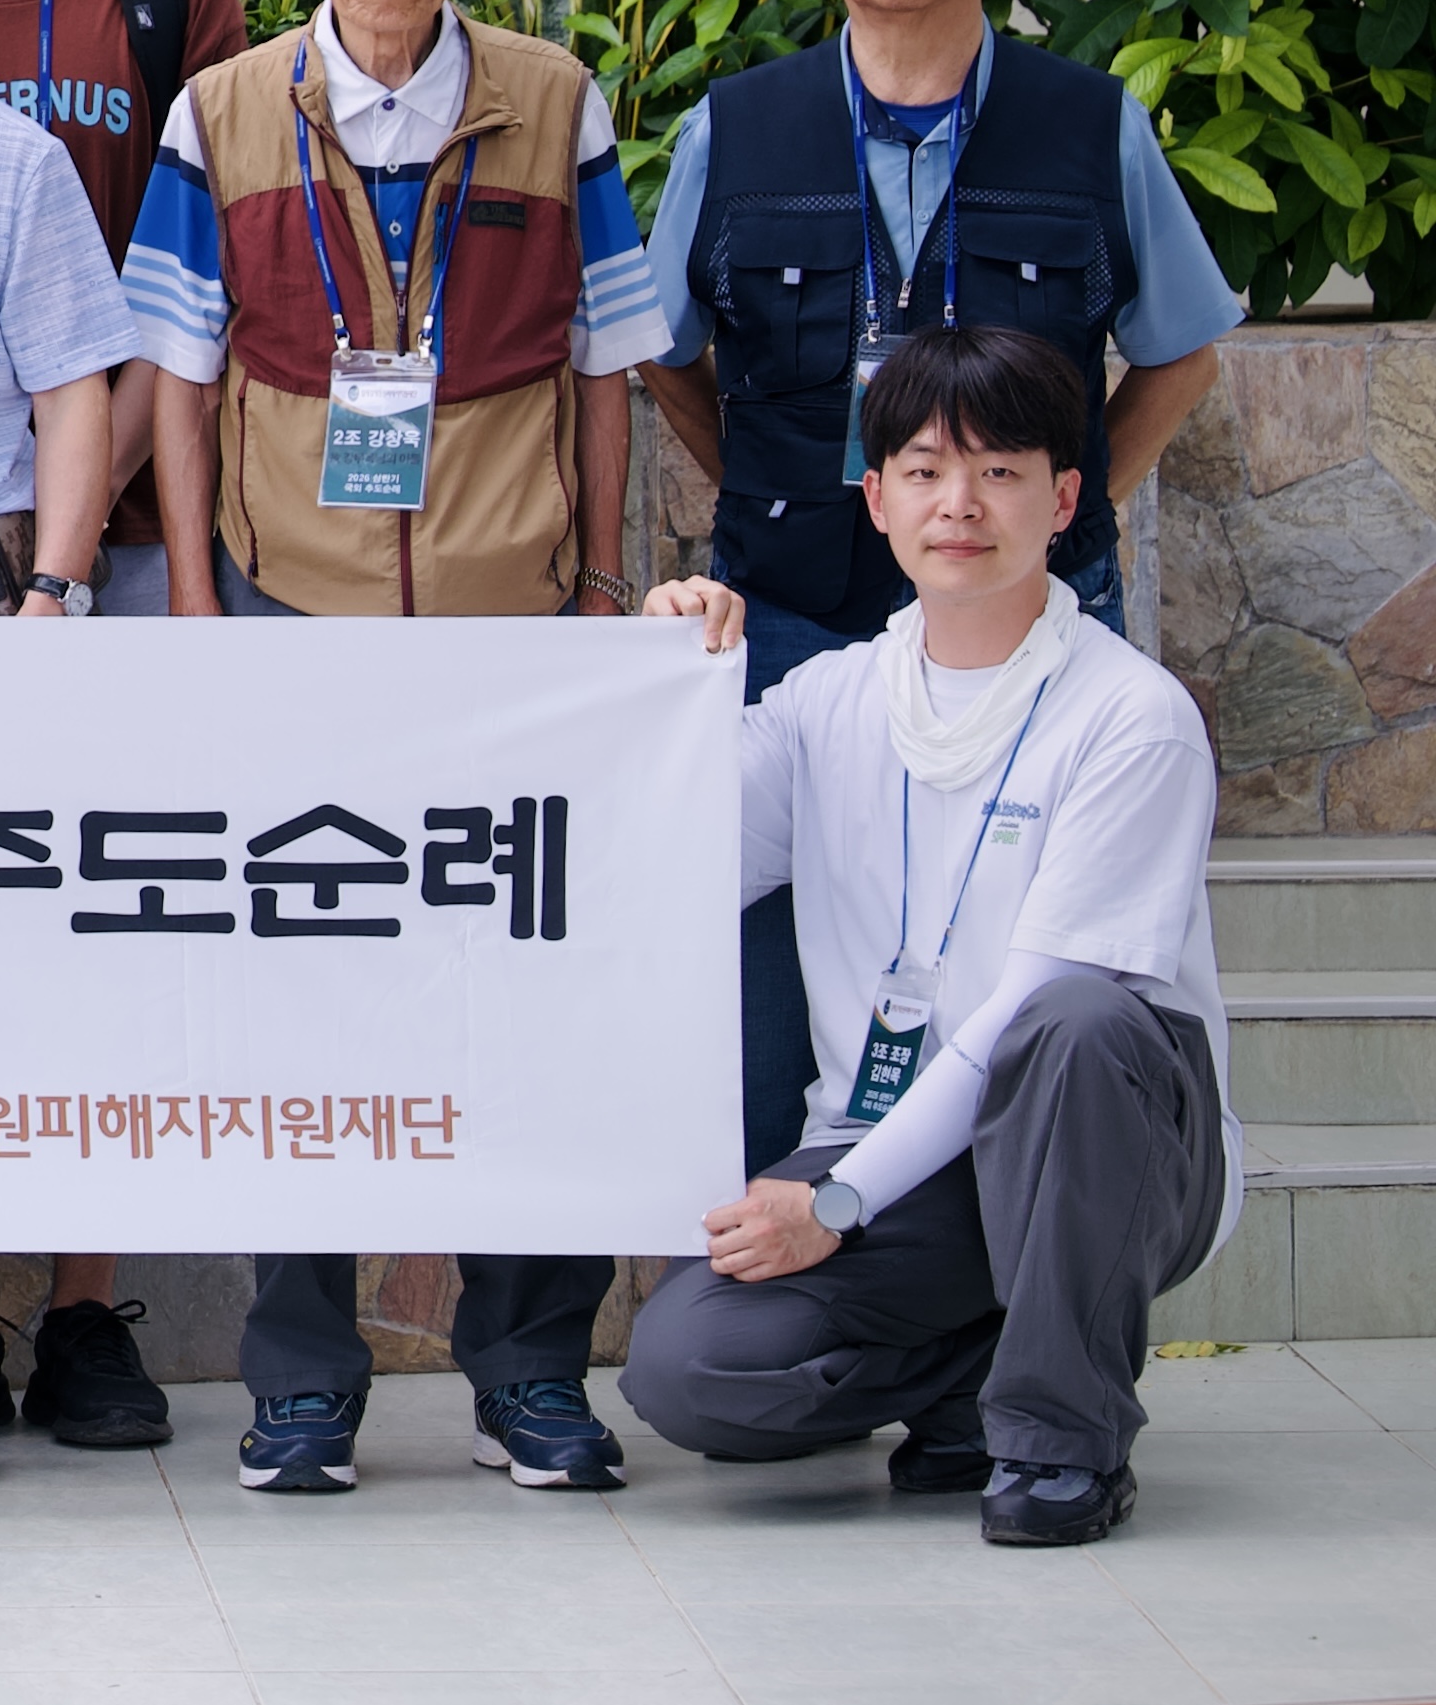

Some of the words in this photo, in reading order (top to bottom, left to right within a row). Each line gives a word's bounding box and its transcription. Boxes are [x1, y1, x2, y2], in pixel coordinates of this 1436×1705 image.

[333, 429, 362, 446] 2조
[367, 429, 422, 449] 강창욱
[347, 473, 370, 483] 2026
[372, 473, 400, 484] 상반기
[870, 1041, 890, 1061] 3조
[889, 1043, 913, 1066] 조장
[869, 1063, 902, 1087] 김현목
